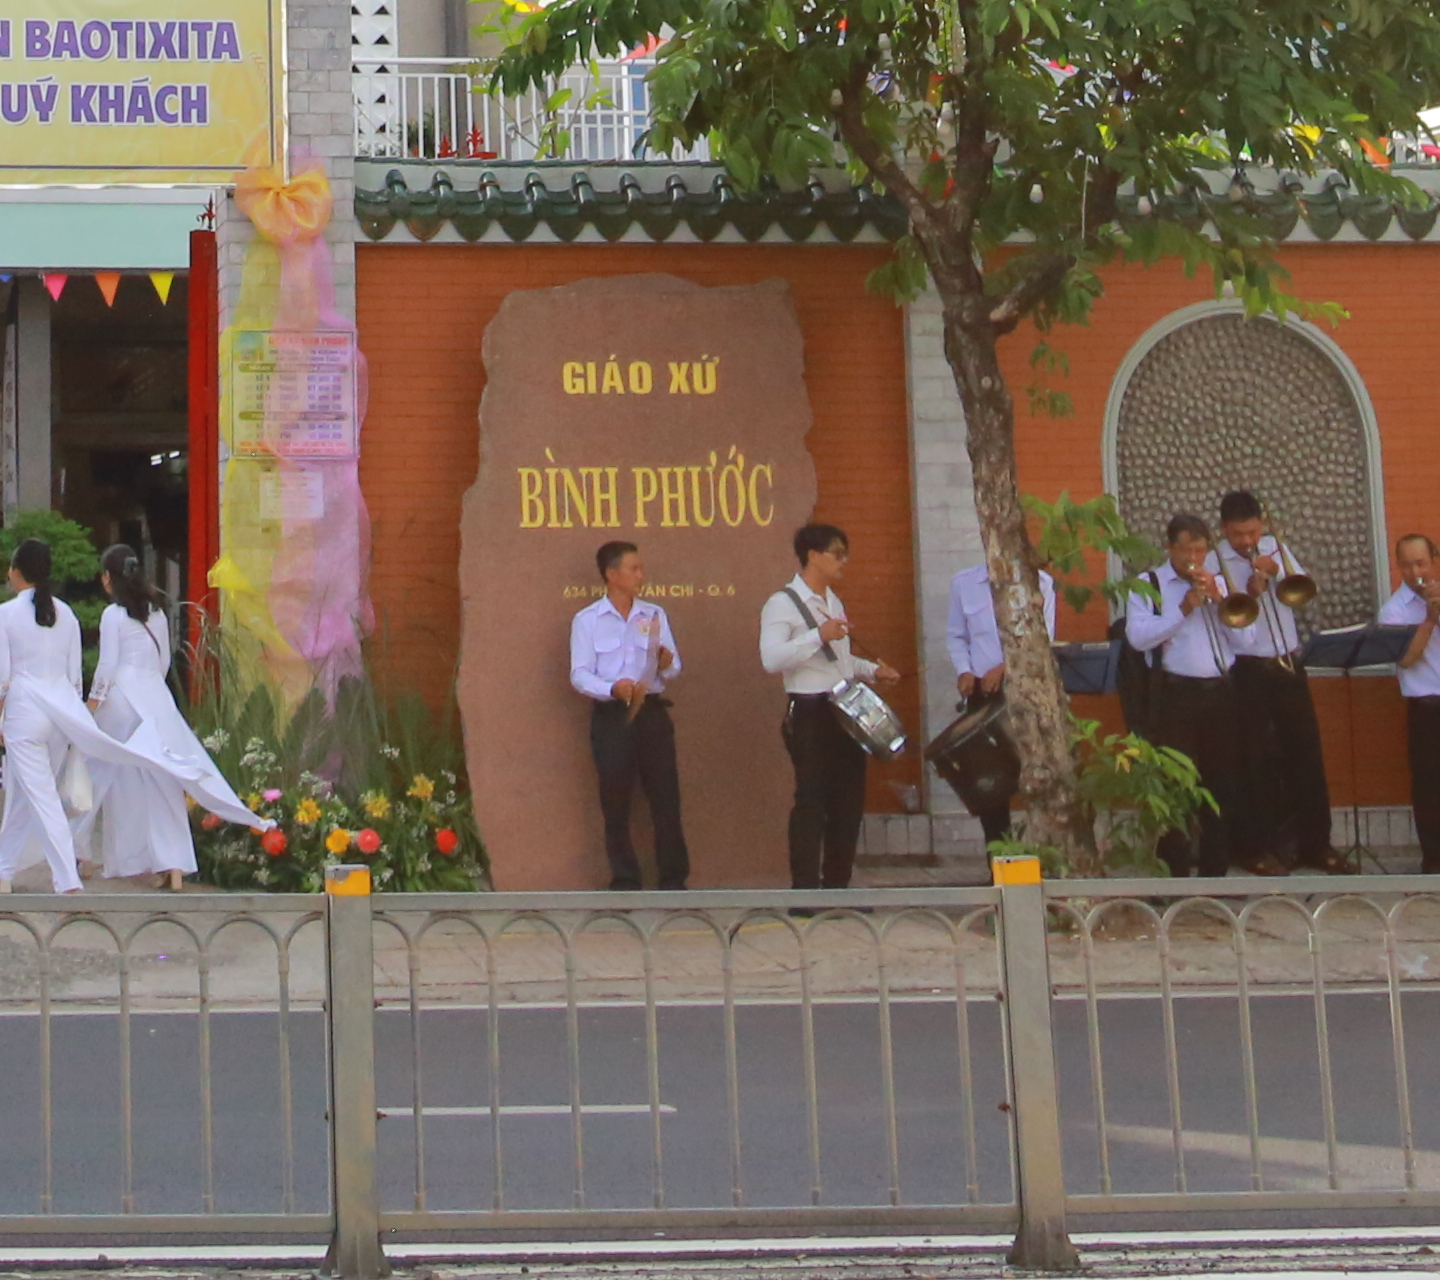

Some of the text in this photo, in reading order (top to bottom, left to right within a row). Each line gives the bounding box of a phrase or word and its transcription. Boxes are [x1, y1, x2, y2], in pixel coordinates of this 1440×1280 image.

[23, 18, 242, 62] BAOTIXITA
[69, 77, 210, 126] KHÁCH
[562, 353, 720, 395] GIÁO XỨ
[517, 443, 775, 529] BÌNH PHƯỚC
